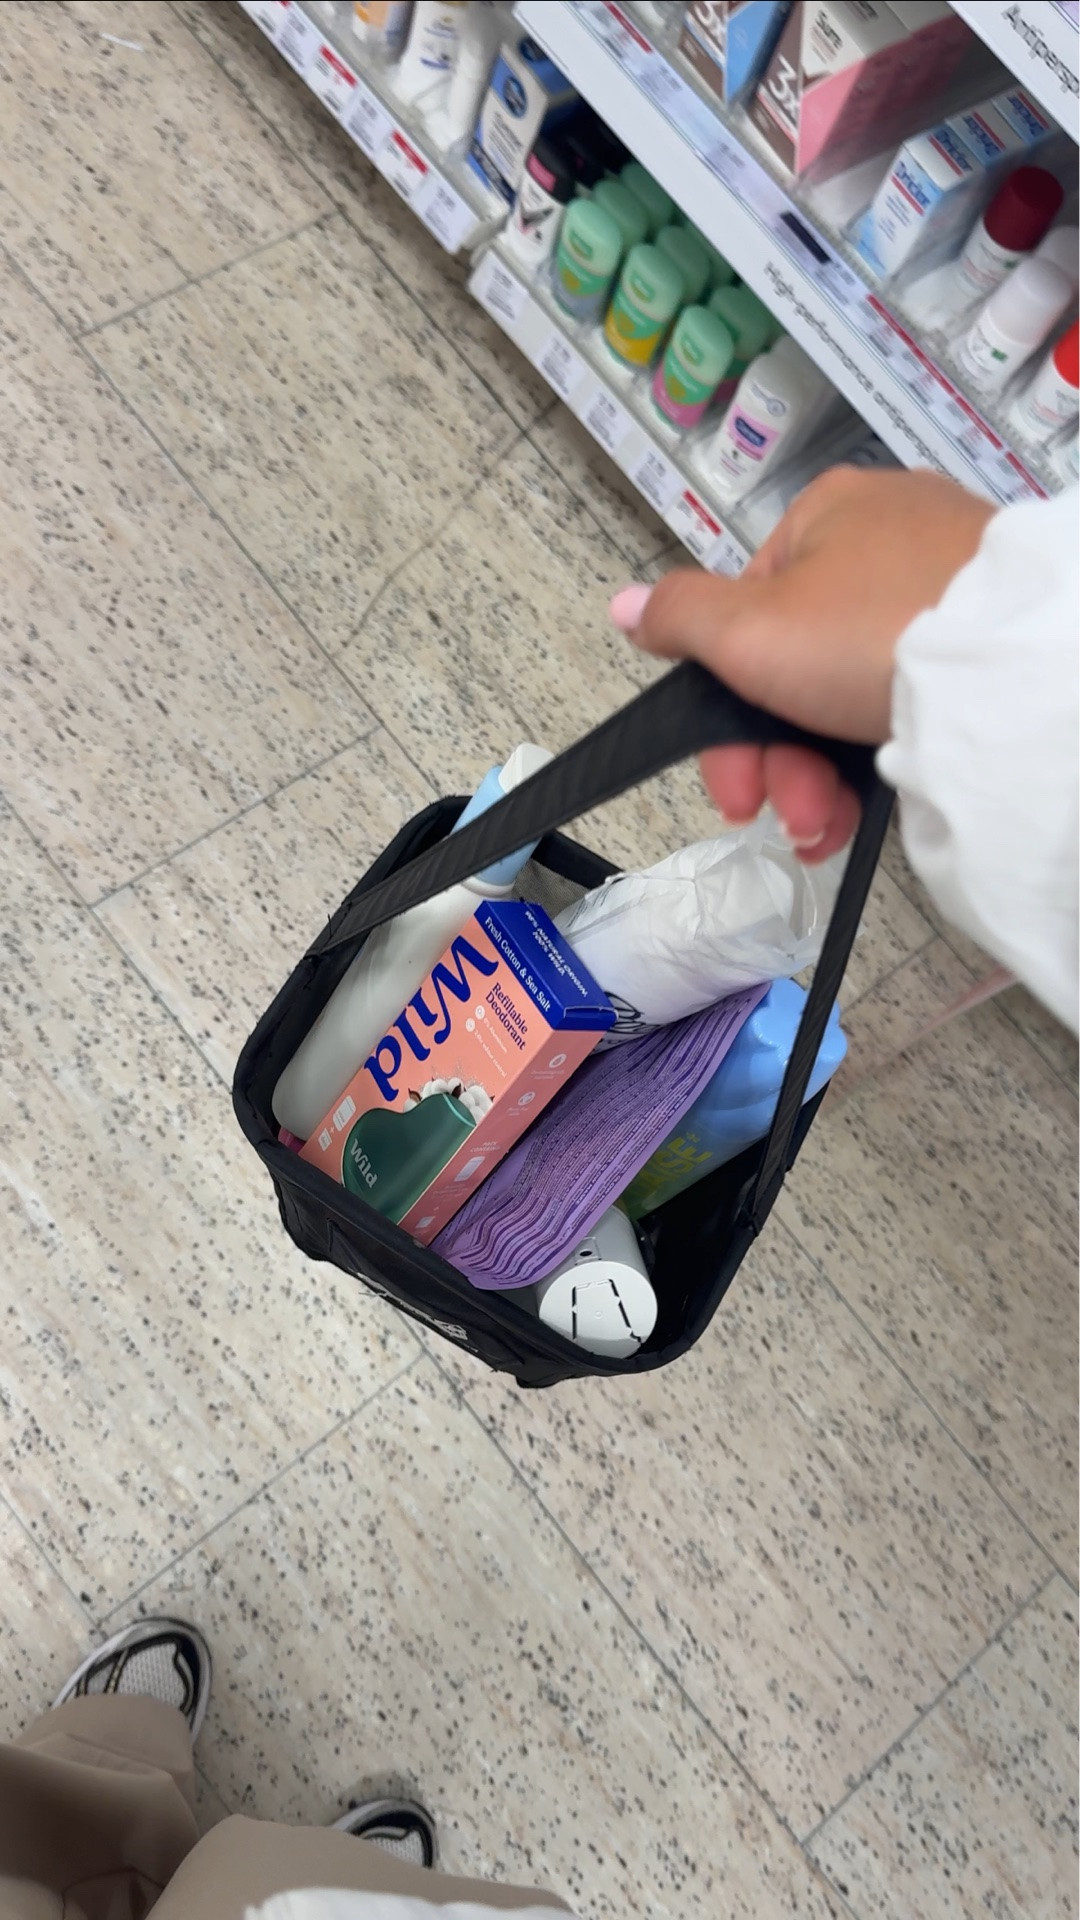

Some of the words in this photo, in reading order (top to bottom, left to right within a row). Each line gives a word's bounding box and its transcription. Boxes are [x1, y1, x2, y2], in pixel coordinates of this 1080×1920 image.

[764, 261, 875, 393] High-performance
[485, 916, 502, 942] Fresh
[501, 940, 521, 971] Cotton
[519, 967, 528, 979] &
[525, 975, 538, 995] Sea
[536, 991, 551, 1012] Salt
[364, 935, 499, 1101] Wild
[485, 991, 526, 1051] Deodorant
[492, 981, 528, 1035] Refillable
[350, 1138, 378, 1189] Wild
